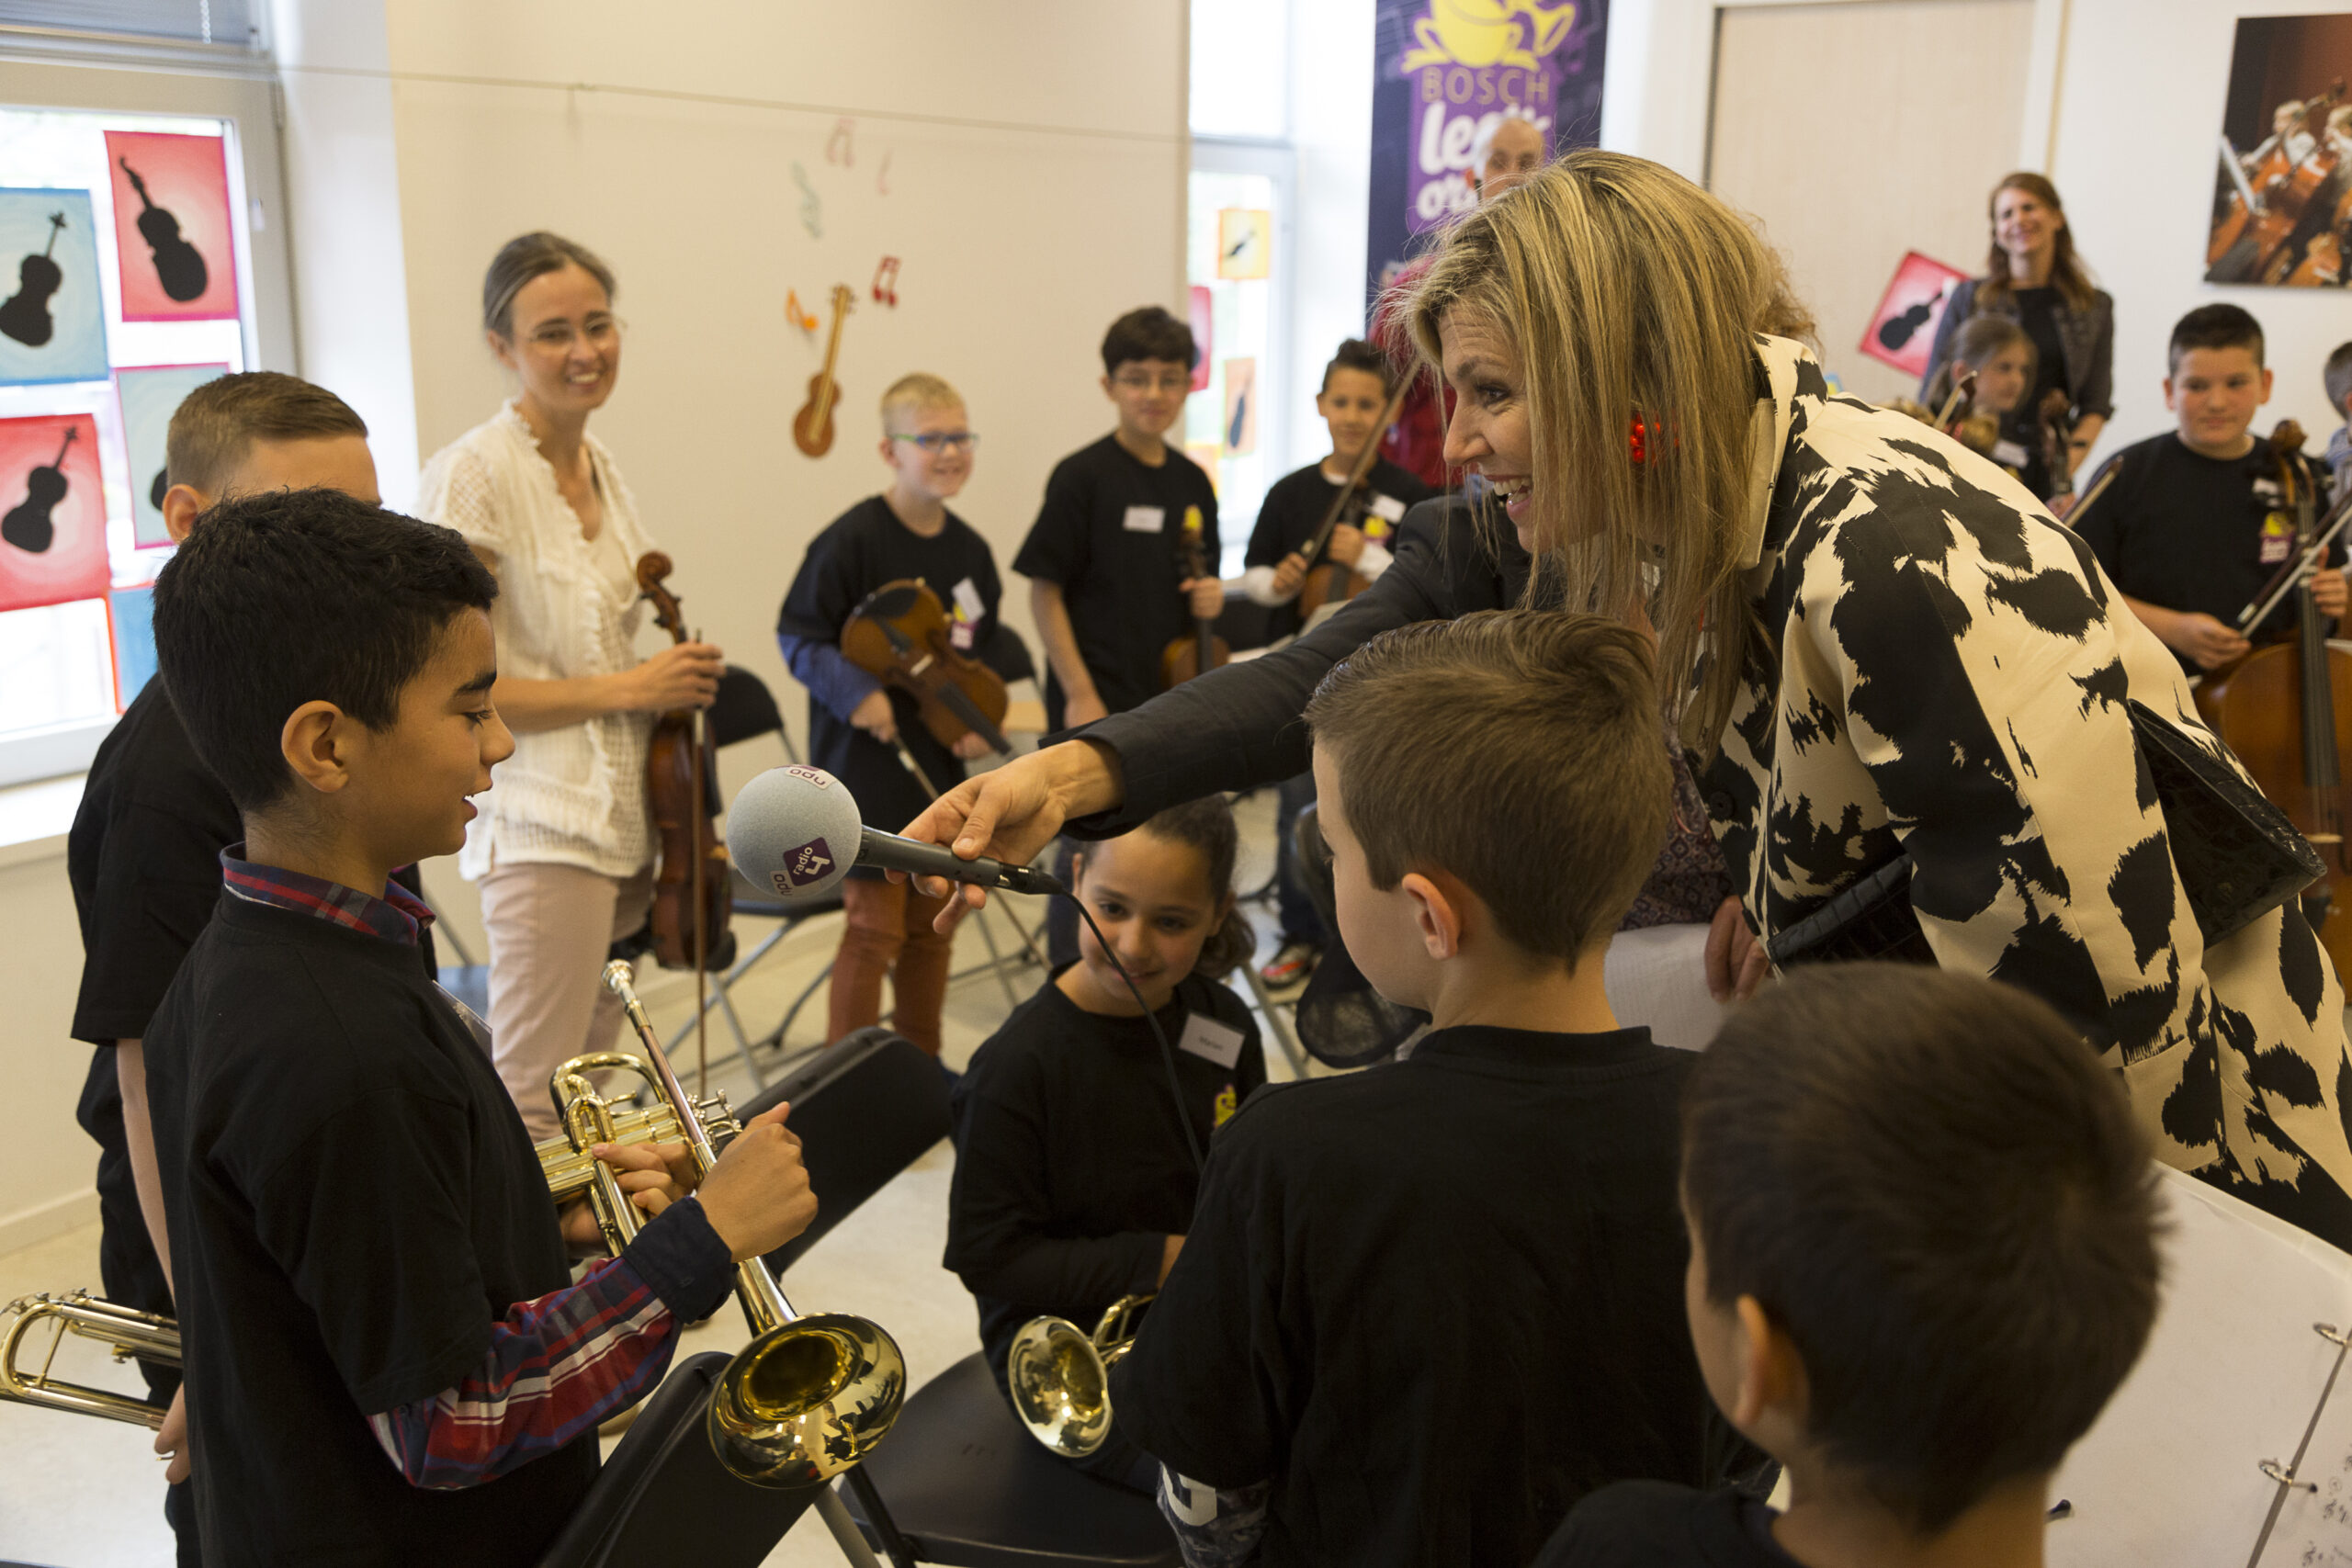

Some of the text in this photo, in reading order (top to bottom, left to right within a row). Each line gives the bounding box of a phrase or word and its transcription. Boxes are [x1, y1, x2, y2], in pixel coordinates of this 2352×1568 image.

[1421, 66, 1551, 105] BOSCH
[789, 768, 827, 785] npo
[793, 846, 814, 875] radio
[805, 855, 831, 875] 4
